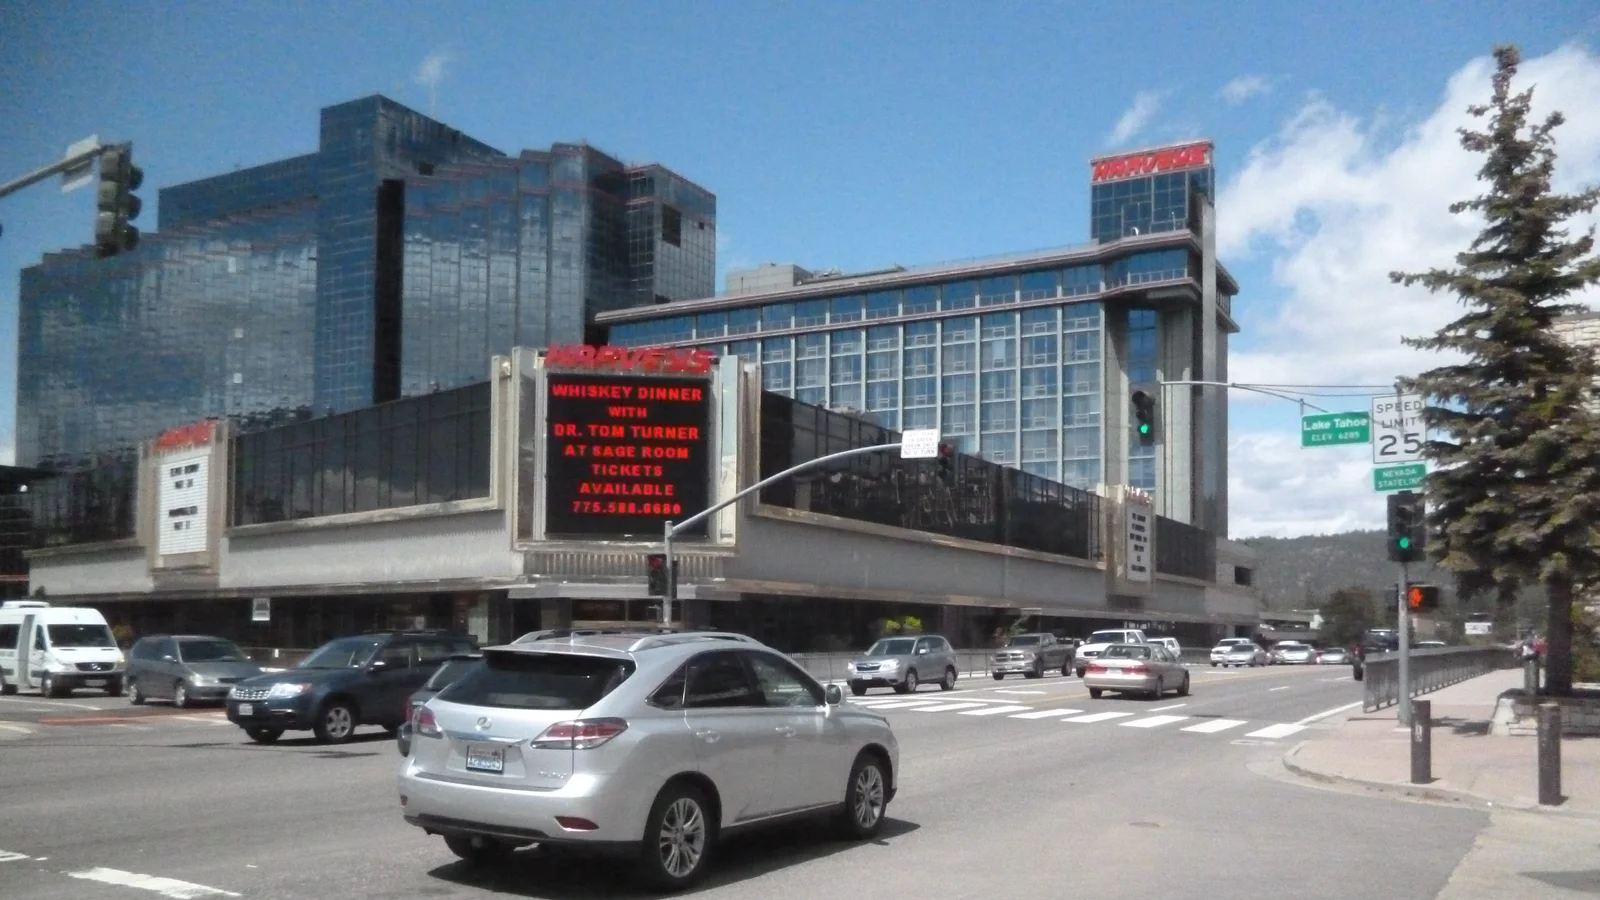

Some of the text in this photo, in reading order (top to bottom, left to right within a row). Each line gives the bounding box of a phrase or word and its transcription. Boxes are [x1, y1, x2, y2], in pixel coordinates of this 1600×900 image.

[552, 384, 702, 401] WHISKEY DINNER
[608, 406, 648, 418] WITH
[1376, 401, 1421, 414] SPEED
[1303, 417, 1368, 431] Lake Tahoe
[1382, 417, 1419, 429] LIMIT
[554, 424, 699, 440] DR. TOM TURNER
[1311, 433, 1333, 442] ELEV
[1379, 432, 1421, 456] 25
[564, 445, 689, 459] AT SAGE ROOM
[591, 464, 664, 477] TICKETS
[1382, 468, 1417, 478] NEVADA
[579, 483, 674, 497] AVAILABLE
